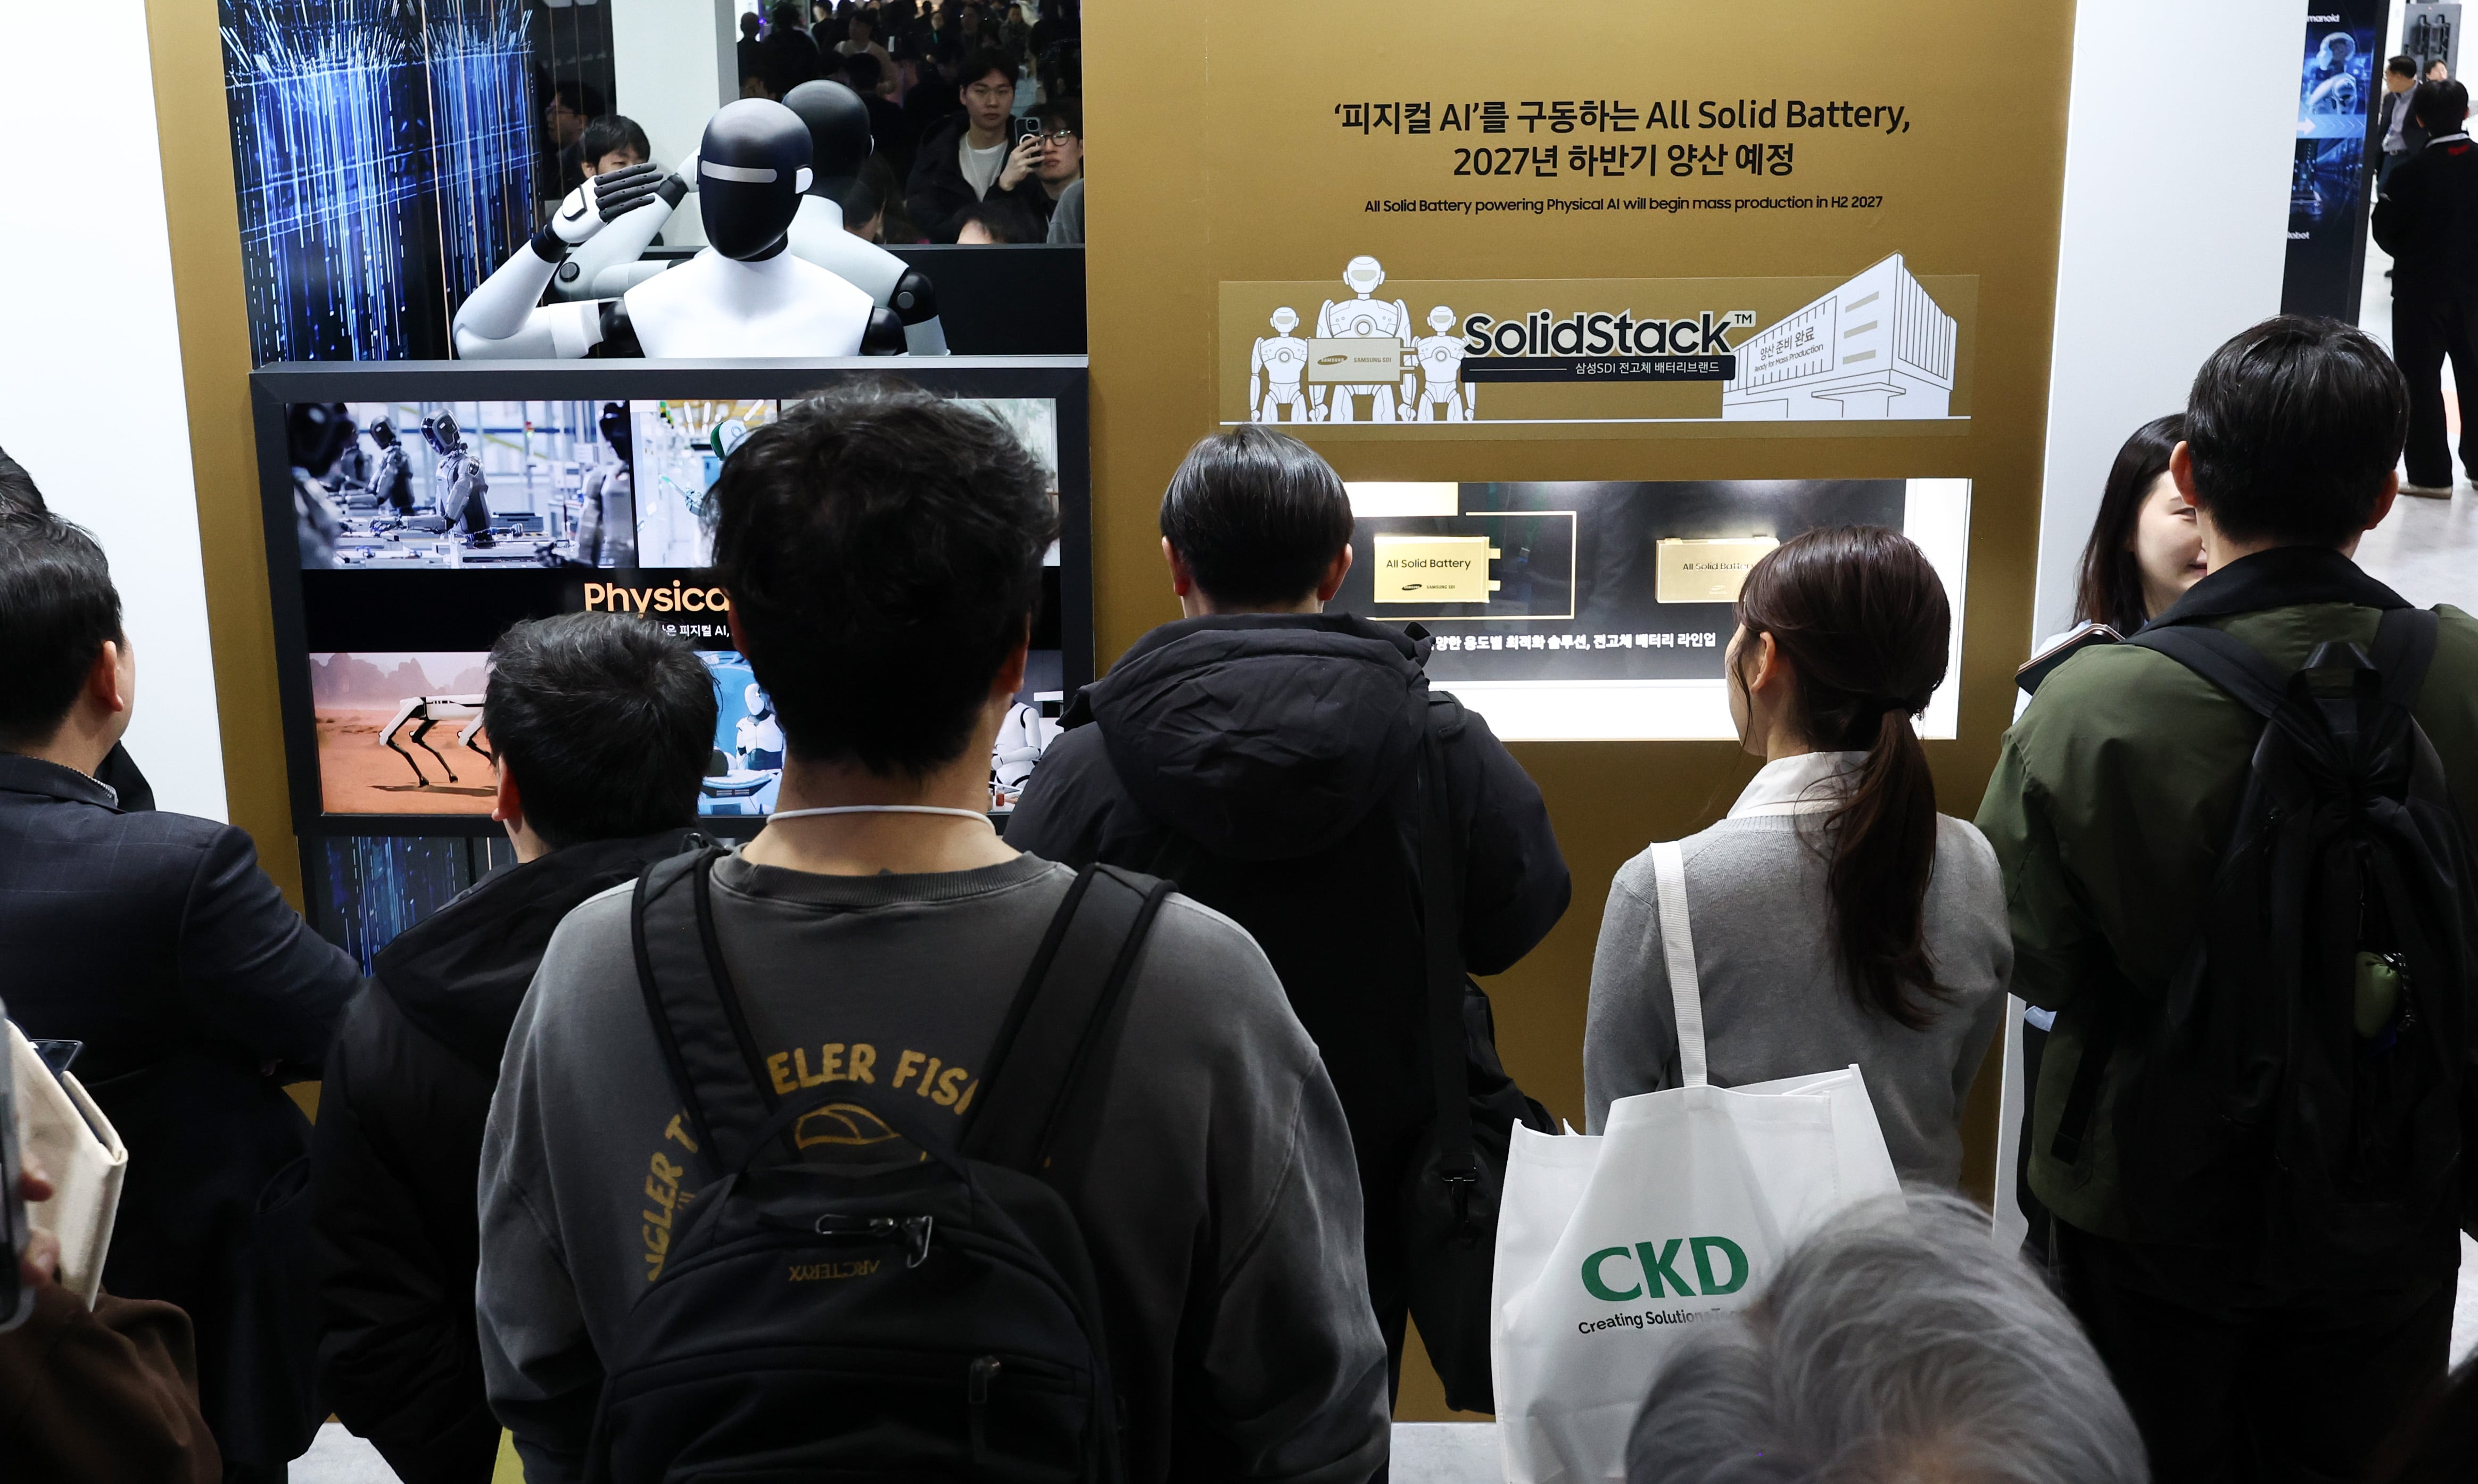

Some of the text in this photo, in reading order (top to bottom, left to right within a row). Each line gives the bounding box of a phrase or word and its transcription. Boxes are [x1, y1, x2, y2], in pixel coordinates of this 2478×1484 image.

[1517, 100, 1639, 134] 구동하는
[1646, 100, 1690, 129] All
[1698, 99, 1777, 129] Solid
[1786, 100, 1910, 135] Battery,
[1453, 143, 1794, 177] 2027년 하반기 양산 예정
[1365, 196, 1883, 215] All Solid Battery powering Physical AI will begin mass production in H2 2027
[1760, 326, 1815, 361] 양산 준비 완료
[1775, 356, 1789, 366] Mass
[1789, 343, 1824, 361] Production
[1575, 361, 1720, 375] 삼성SDI 전고체 배터리브랜드
[1386, 559, 1471, 570] All Solid Battery
[1695, 562, 1719, 571] Solid
[679, 624, 712, 637] 피지컬
[1431, 635, 1463, 651] 양한
[1463, 635, 1503, 651] 용도별
[1505, 634, 1546, 650] 최적화
[1593, 633, 1633, 649] 전고체
[1635, 633, 1674, 648] 배터리
[1677, 632, 1716, 648] 라인업
[1581, 1236, 1749, 1301] CKD
[1578, 1313, 1644, 1334] Creating
